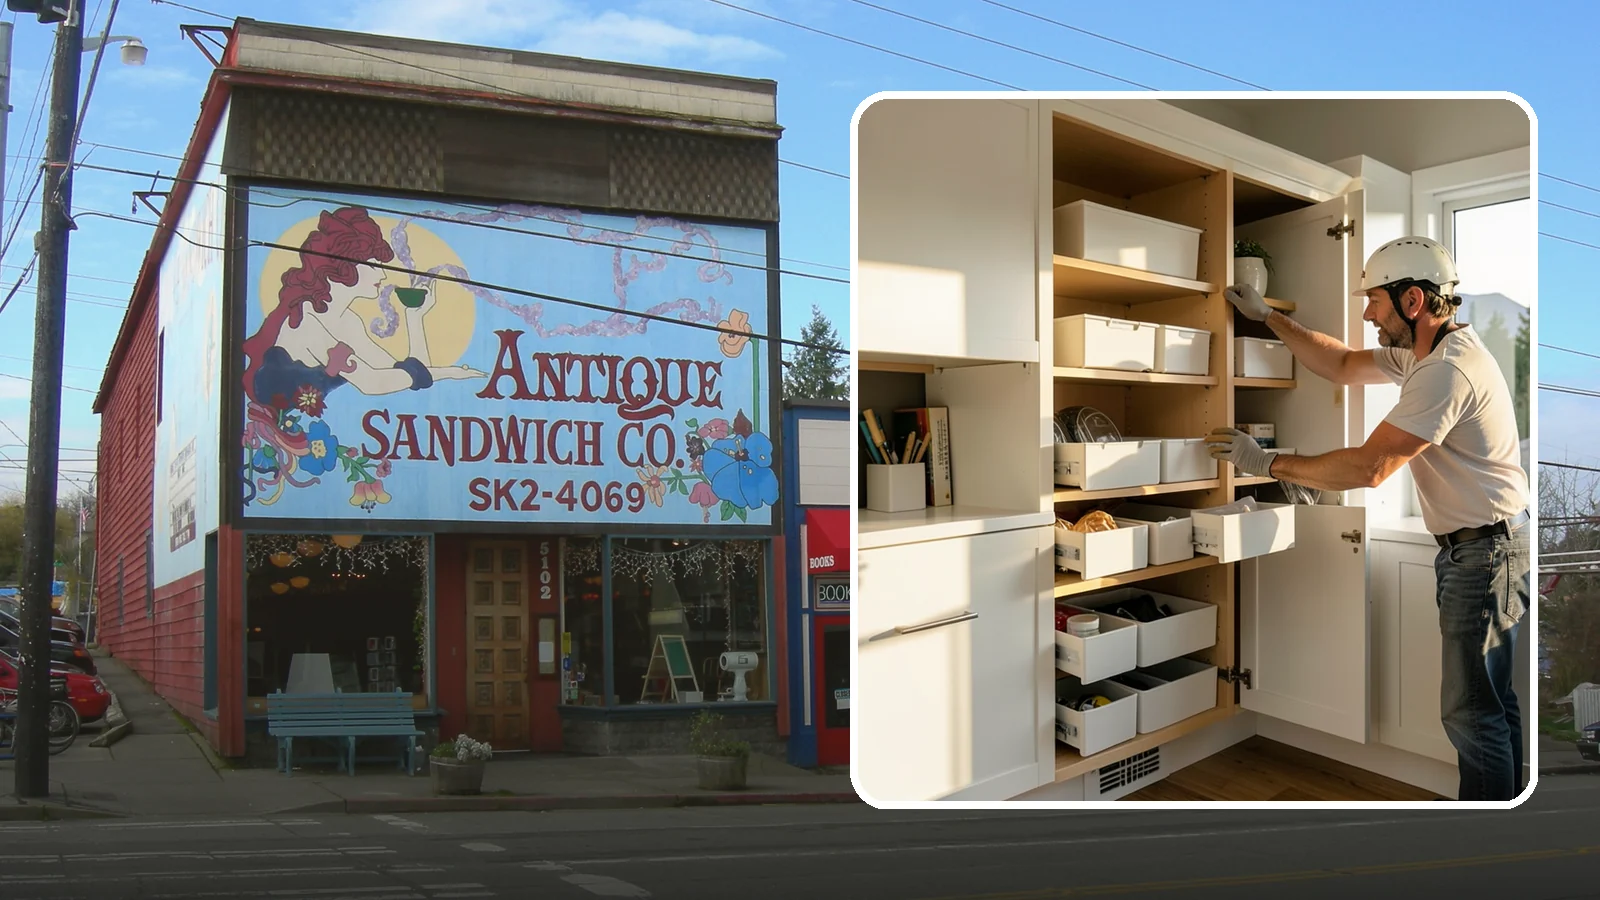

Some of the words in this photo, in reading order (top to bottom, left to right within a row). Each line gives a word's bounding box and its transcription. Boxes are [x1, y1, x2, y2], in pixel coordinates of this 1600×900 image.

[476, 328, 724, 421] ANTIQUE
[361, 408, 604, 467] SANDWICH
[617, 421, 685, 469] CO.
[468, 476, 645, 512] SK2-4069
[540, 541, 552, 600] 5102
[809, 555, 835, 569] BOOKS
